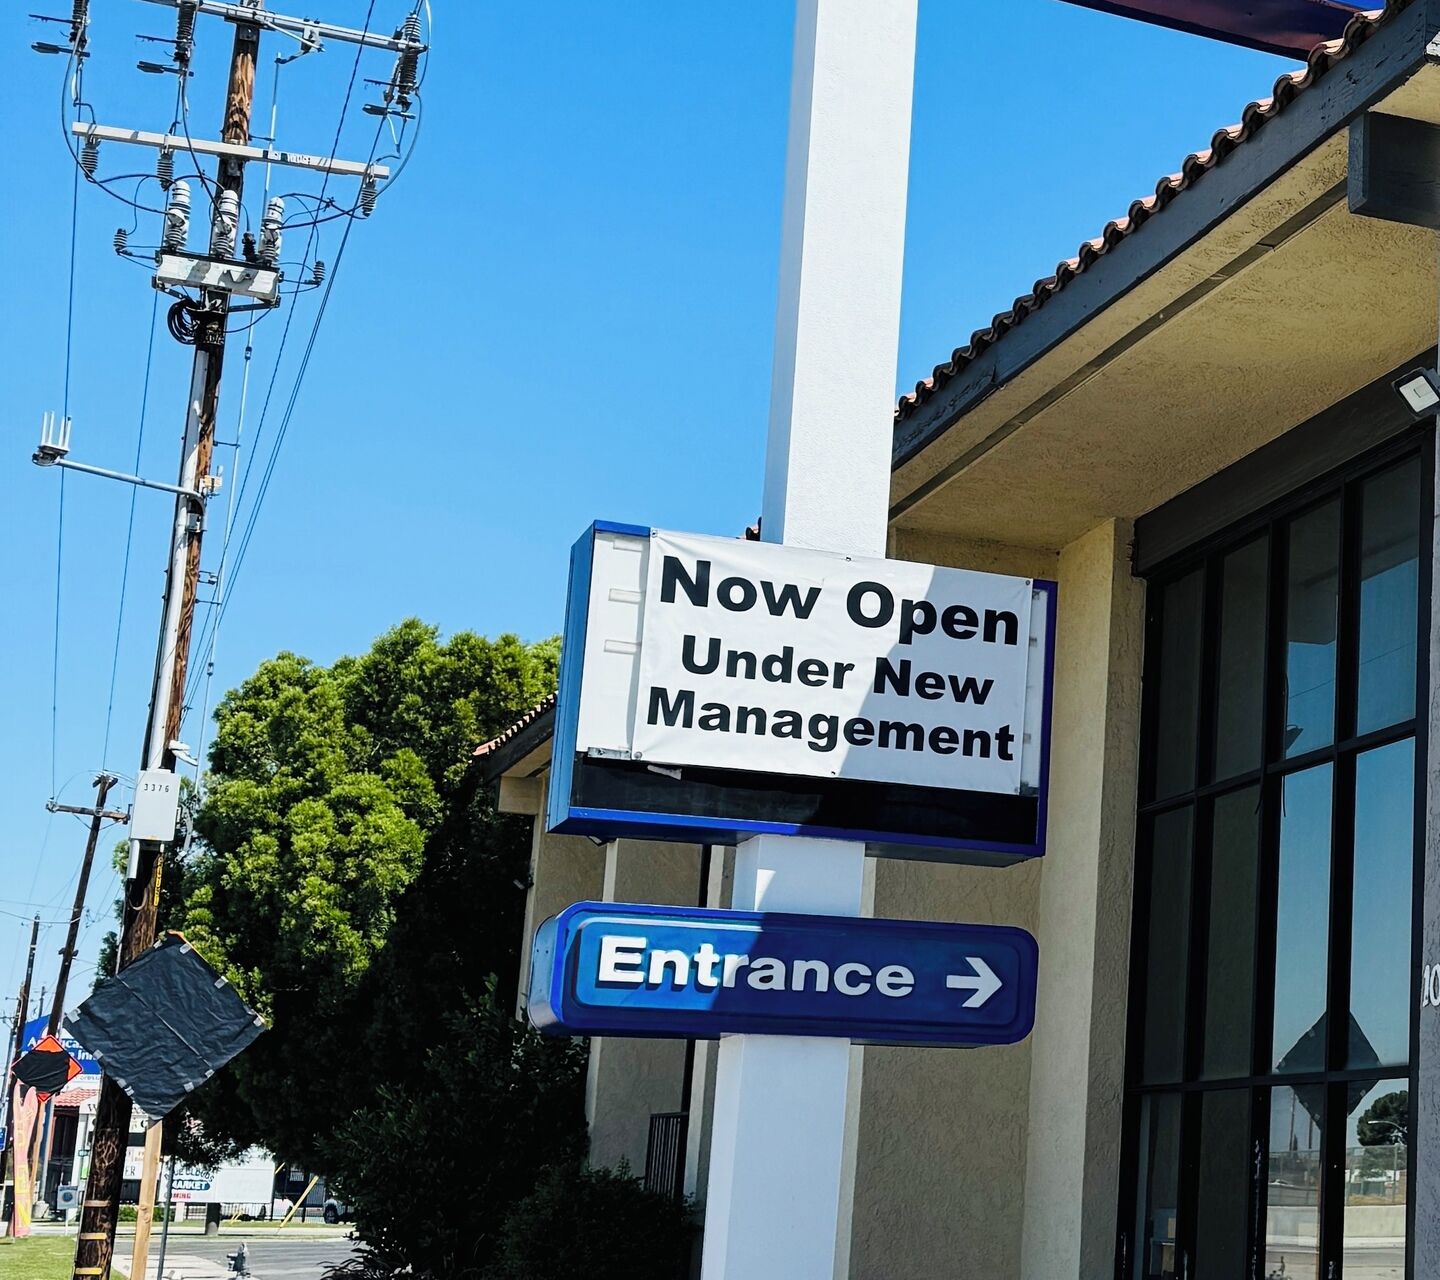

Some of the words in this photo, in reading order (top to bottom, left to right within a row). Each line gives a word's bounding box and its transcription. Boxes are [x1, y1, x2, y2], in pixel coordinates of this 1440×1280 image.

[660, 555, 822, 620] Now
[846, 581, 1019, 646] Open
[682, 634, 856, 690] Under
[873, 656, 995, 705] New
[647, 686, 1015, 761] Management
[144, 783, 170, 793] 3376
[598, 935, 915, 998] Entrance
